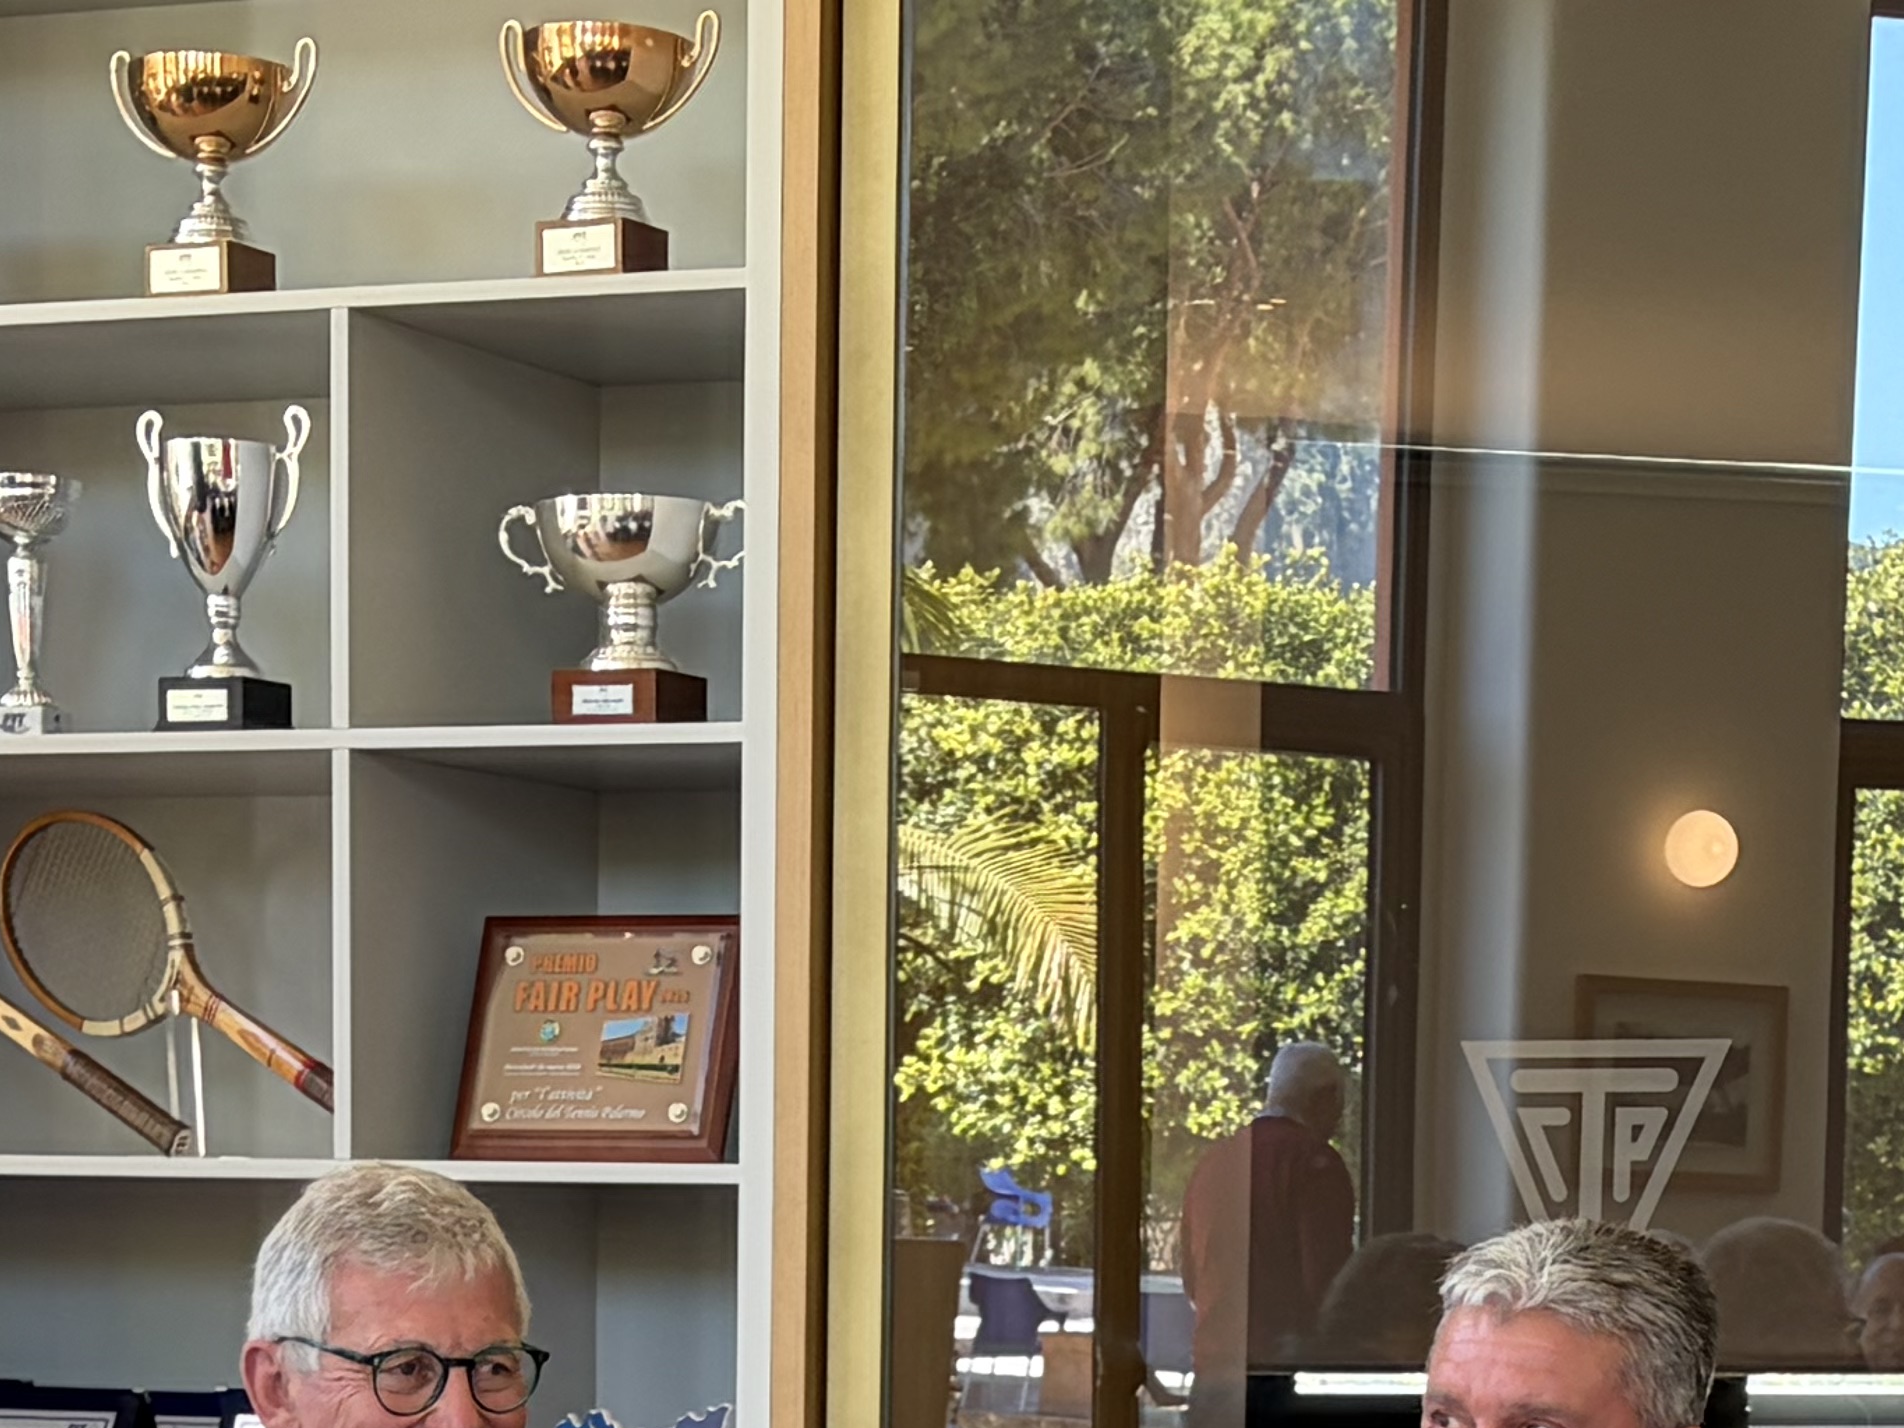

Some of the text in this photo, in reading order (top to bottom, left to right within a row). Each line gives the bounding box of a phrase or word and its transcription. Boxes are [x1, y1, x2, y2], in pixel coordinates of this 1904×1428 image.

[530, 953, 598, 974] PREMIO
[514, 979, 582, 1013] FAIR
[586, 978, 659, 1013] PLAY
